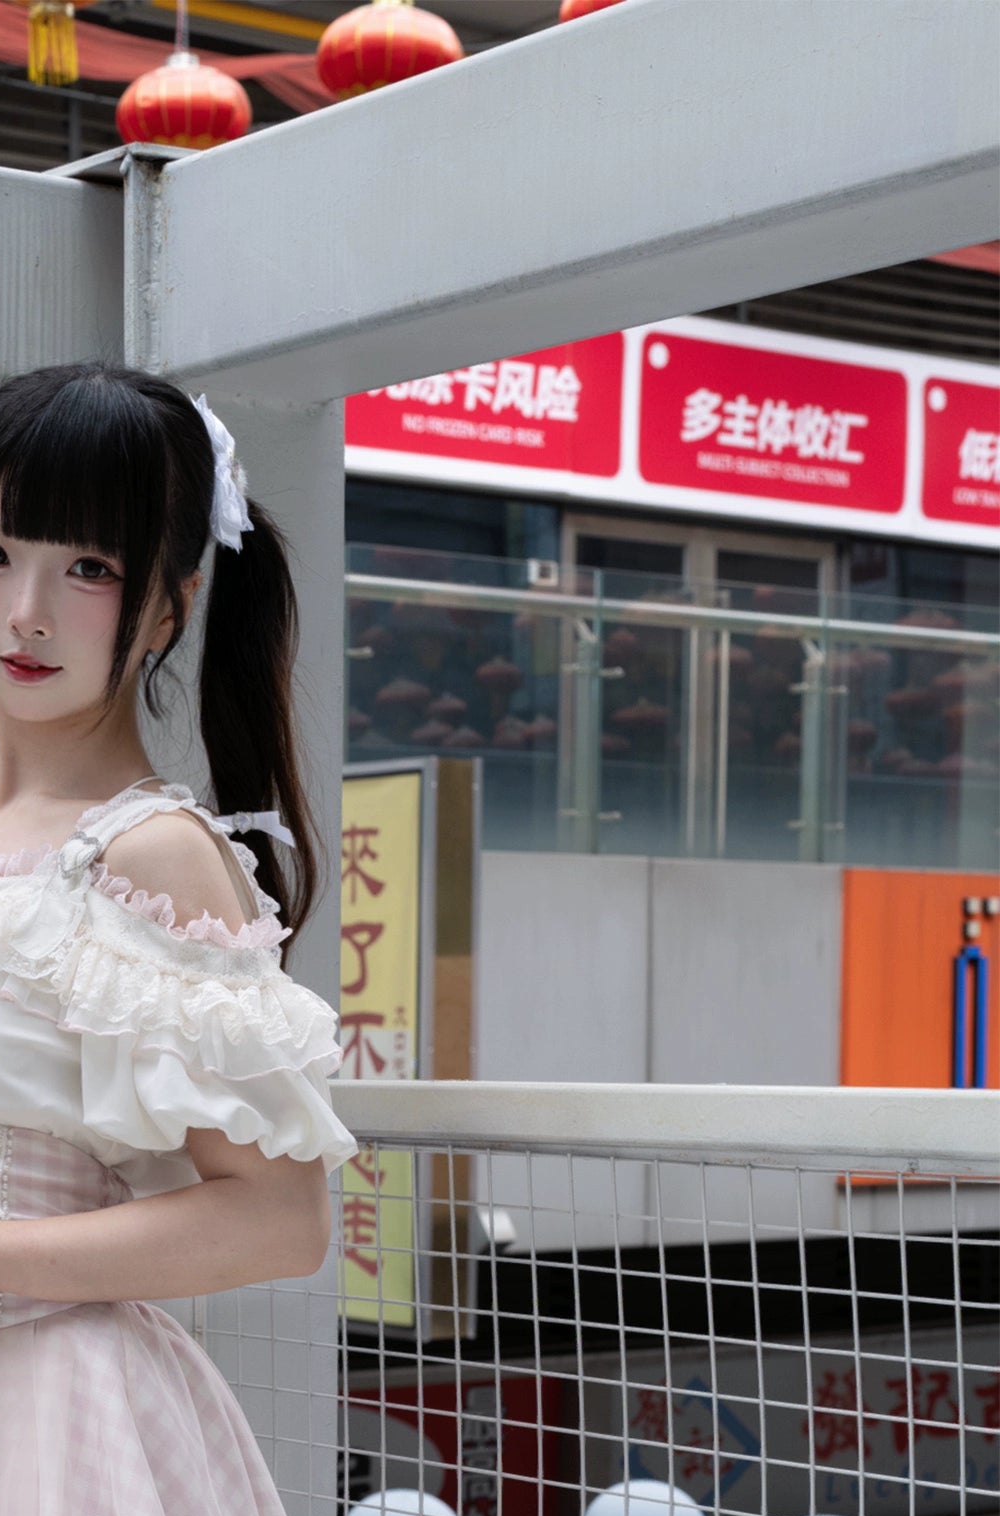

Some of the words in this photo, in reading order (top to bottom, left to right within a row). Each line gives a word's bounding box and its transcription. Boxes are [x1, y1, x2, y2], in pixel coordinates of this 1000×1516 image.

[680, 388, 868, 464] 多主体收汇
[958, 427, 1000, 483] 低
